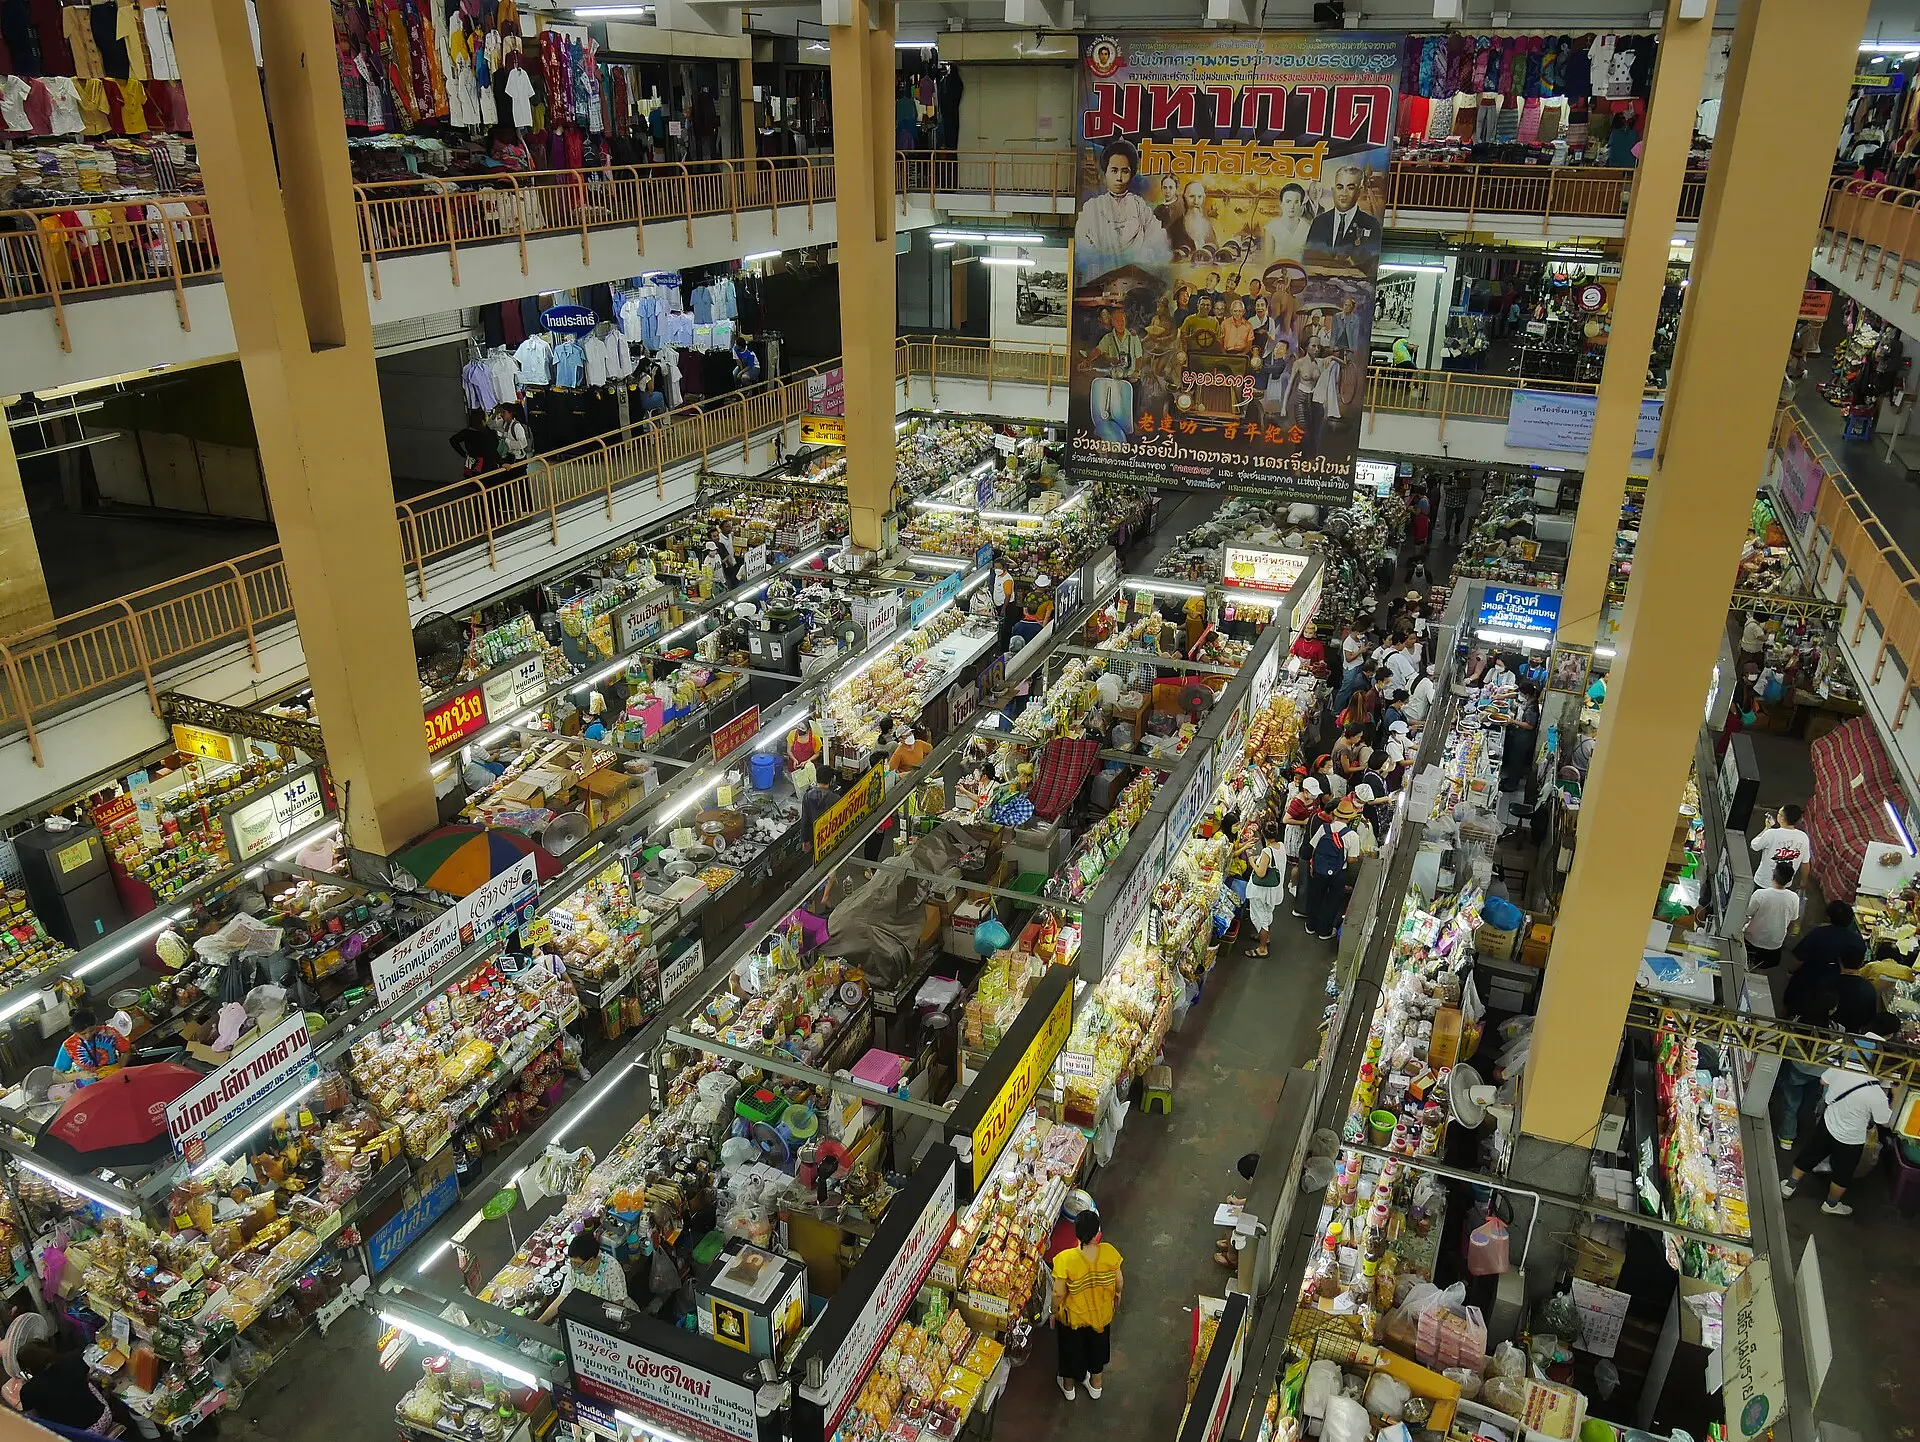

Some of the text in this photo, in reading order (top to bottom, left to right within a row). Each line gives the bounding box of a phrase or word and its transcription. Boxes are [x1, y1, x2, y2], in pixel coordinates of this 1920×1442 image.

[1083, 82, 1393, 147] มหากาด
[545, 311, 596, 328] ไทยประสิทธิ์
[1218, 469, 1233, 478] และ
[1495, 590, 1540, 607] ดำรงค์
[869, 606, 895, 632] เหมียว
[284, 781, 307, 802] นุช
[664, 944, 699, 989] ร้านโชคดี
[171, 1027, 308, 1140] เป็ดพะโล้กาดหลวง
[569, 1322, 618, 1349] ร้านน้องนุช
[577, 1338, 620, 1362] หมูยอ
[574, 1353, 655, 1392] หมูยอพริกไทยดำ
[659, 1385, 754, 1429] เจ้าแรกในเชียงใหม่
[724, 1422, 736, 1433] และ
[738, 1427, 753, 1439] GMP
